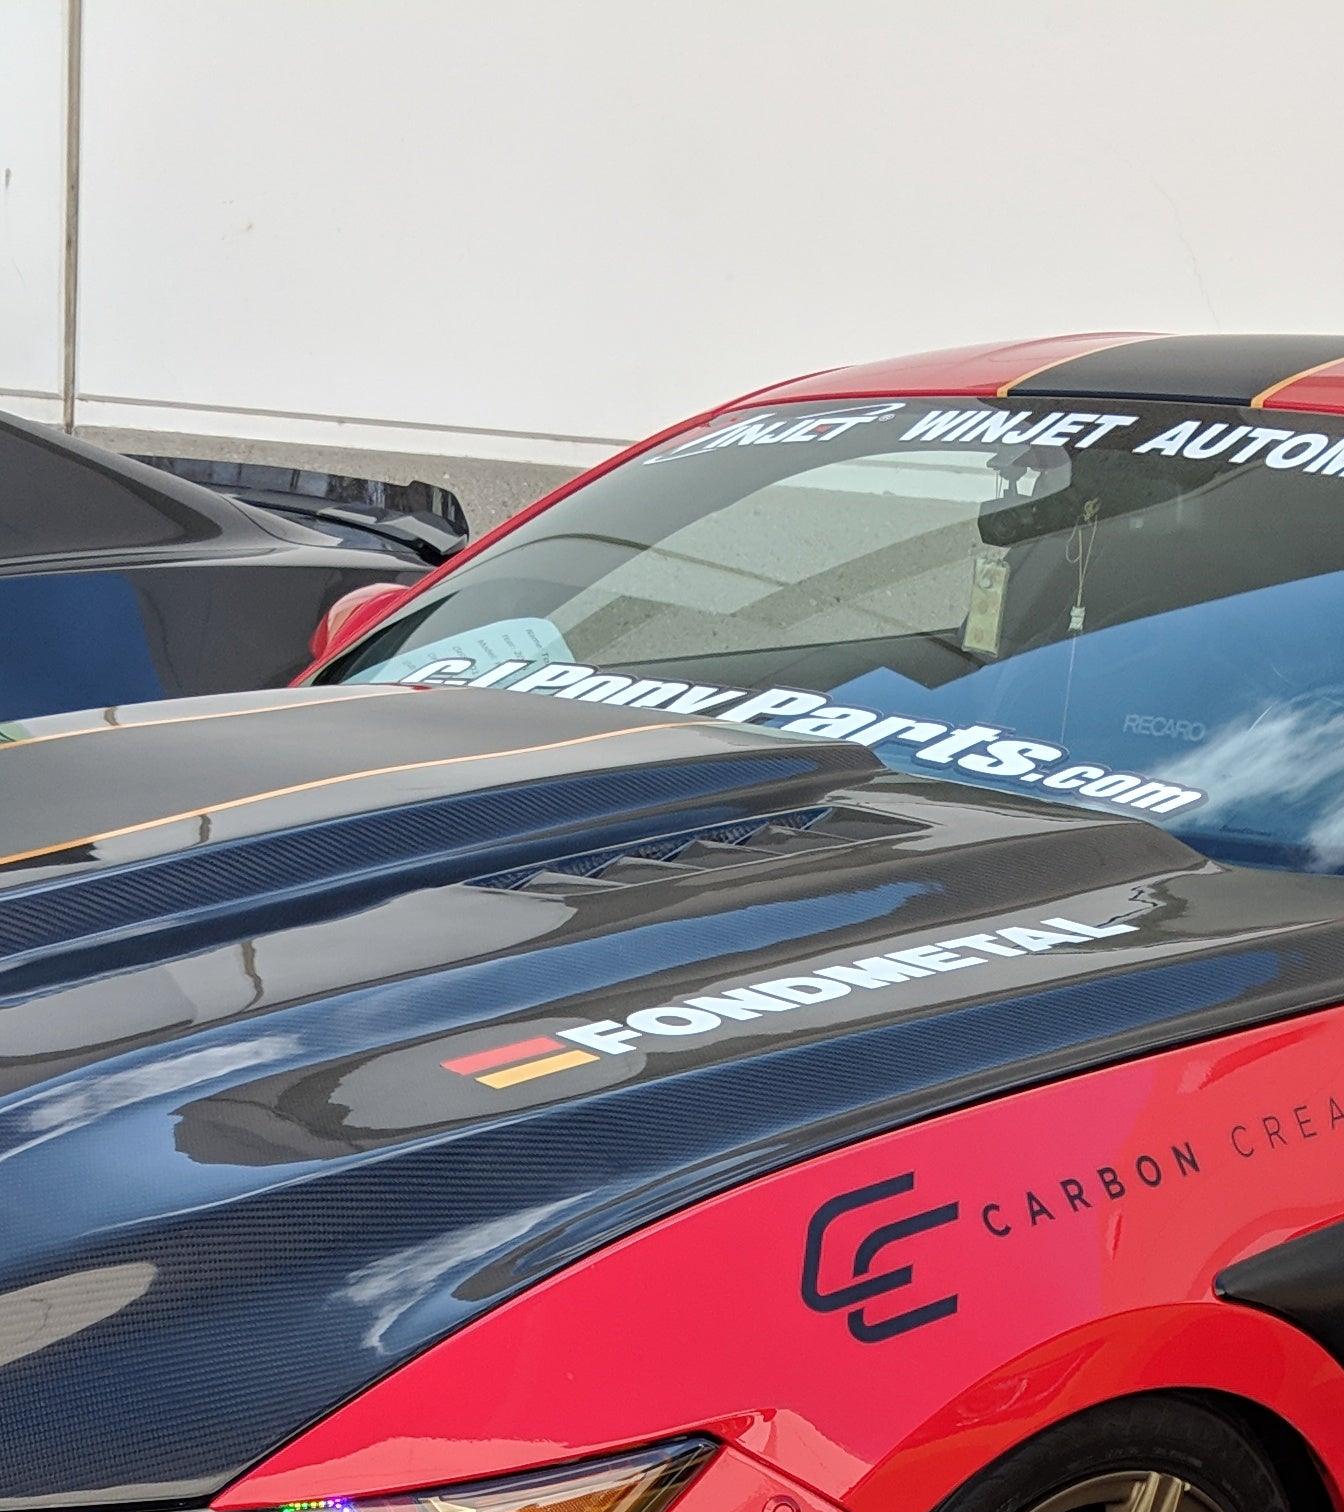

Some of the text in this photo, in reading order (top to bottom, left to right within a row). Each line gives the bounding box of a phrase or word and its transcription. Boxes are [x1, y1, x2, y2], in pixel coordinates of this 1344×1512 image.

[898, 411, 1138, 448] WINJET
[1122, 713, 1206, 743] RECARO
[556, 917, 1140, 1056] FONDMETAL
[981, 1141, 1201, 1236] CARBON
